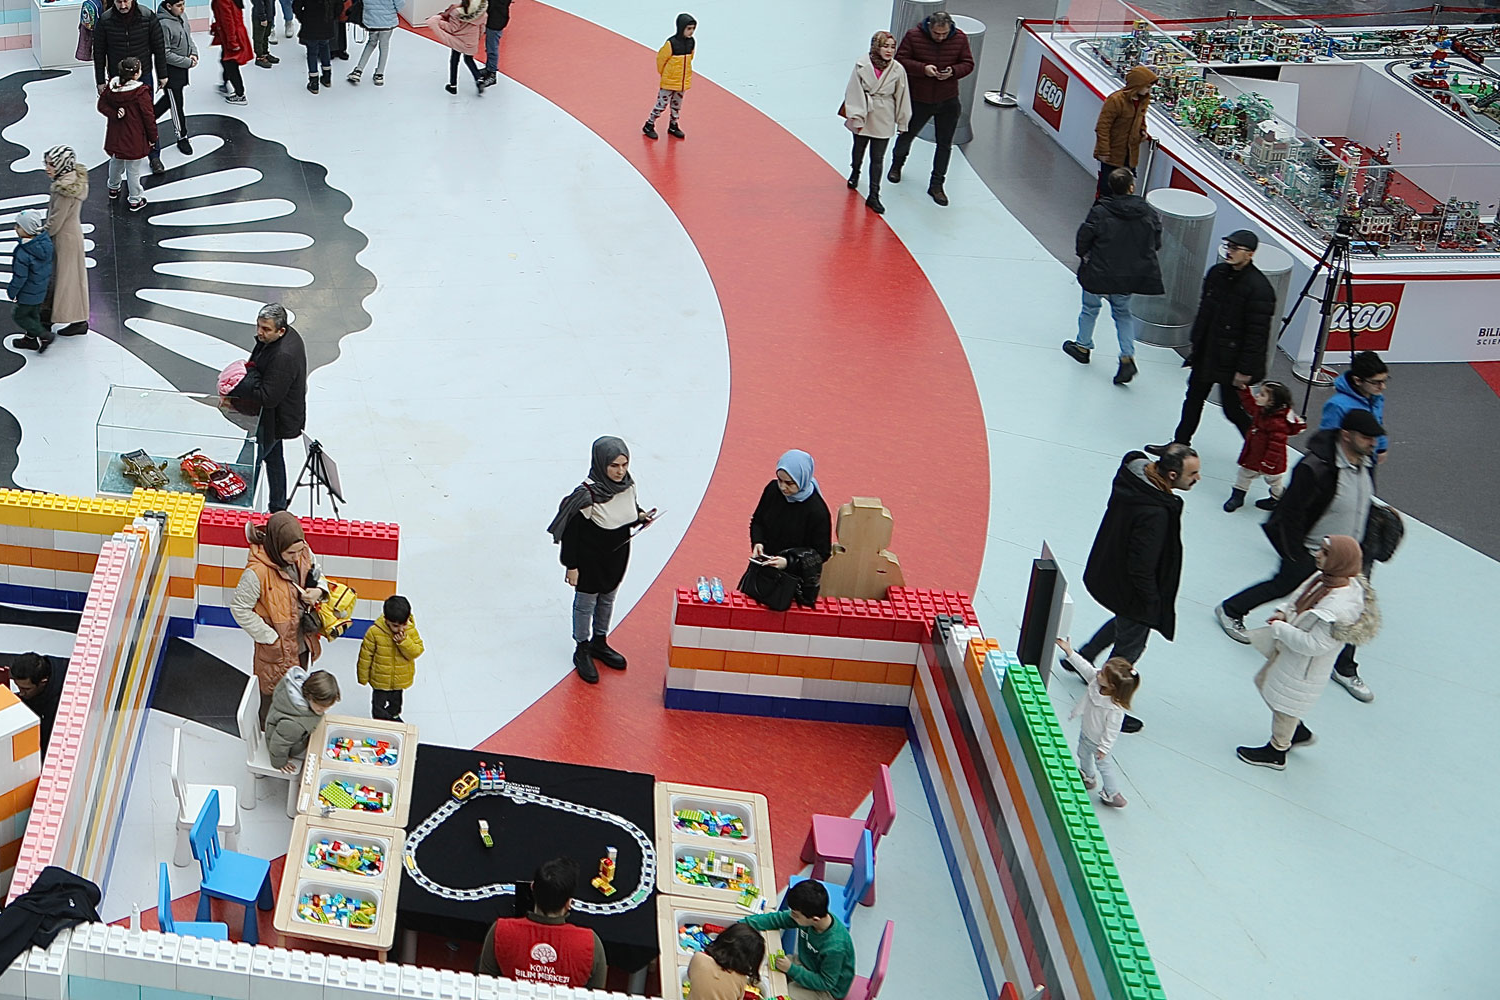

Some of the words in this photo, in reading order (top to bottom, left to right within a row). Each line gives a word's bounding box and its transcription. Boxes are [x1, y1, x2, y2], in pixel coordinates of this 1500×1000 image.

[1037, 75, 1064, 110] LEGO
[1329, 303, 1395, 332] LEGO
[1478, 327, 1500, 337] BiLi
[530, 963, 556, 974] KONYA
